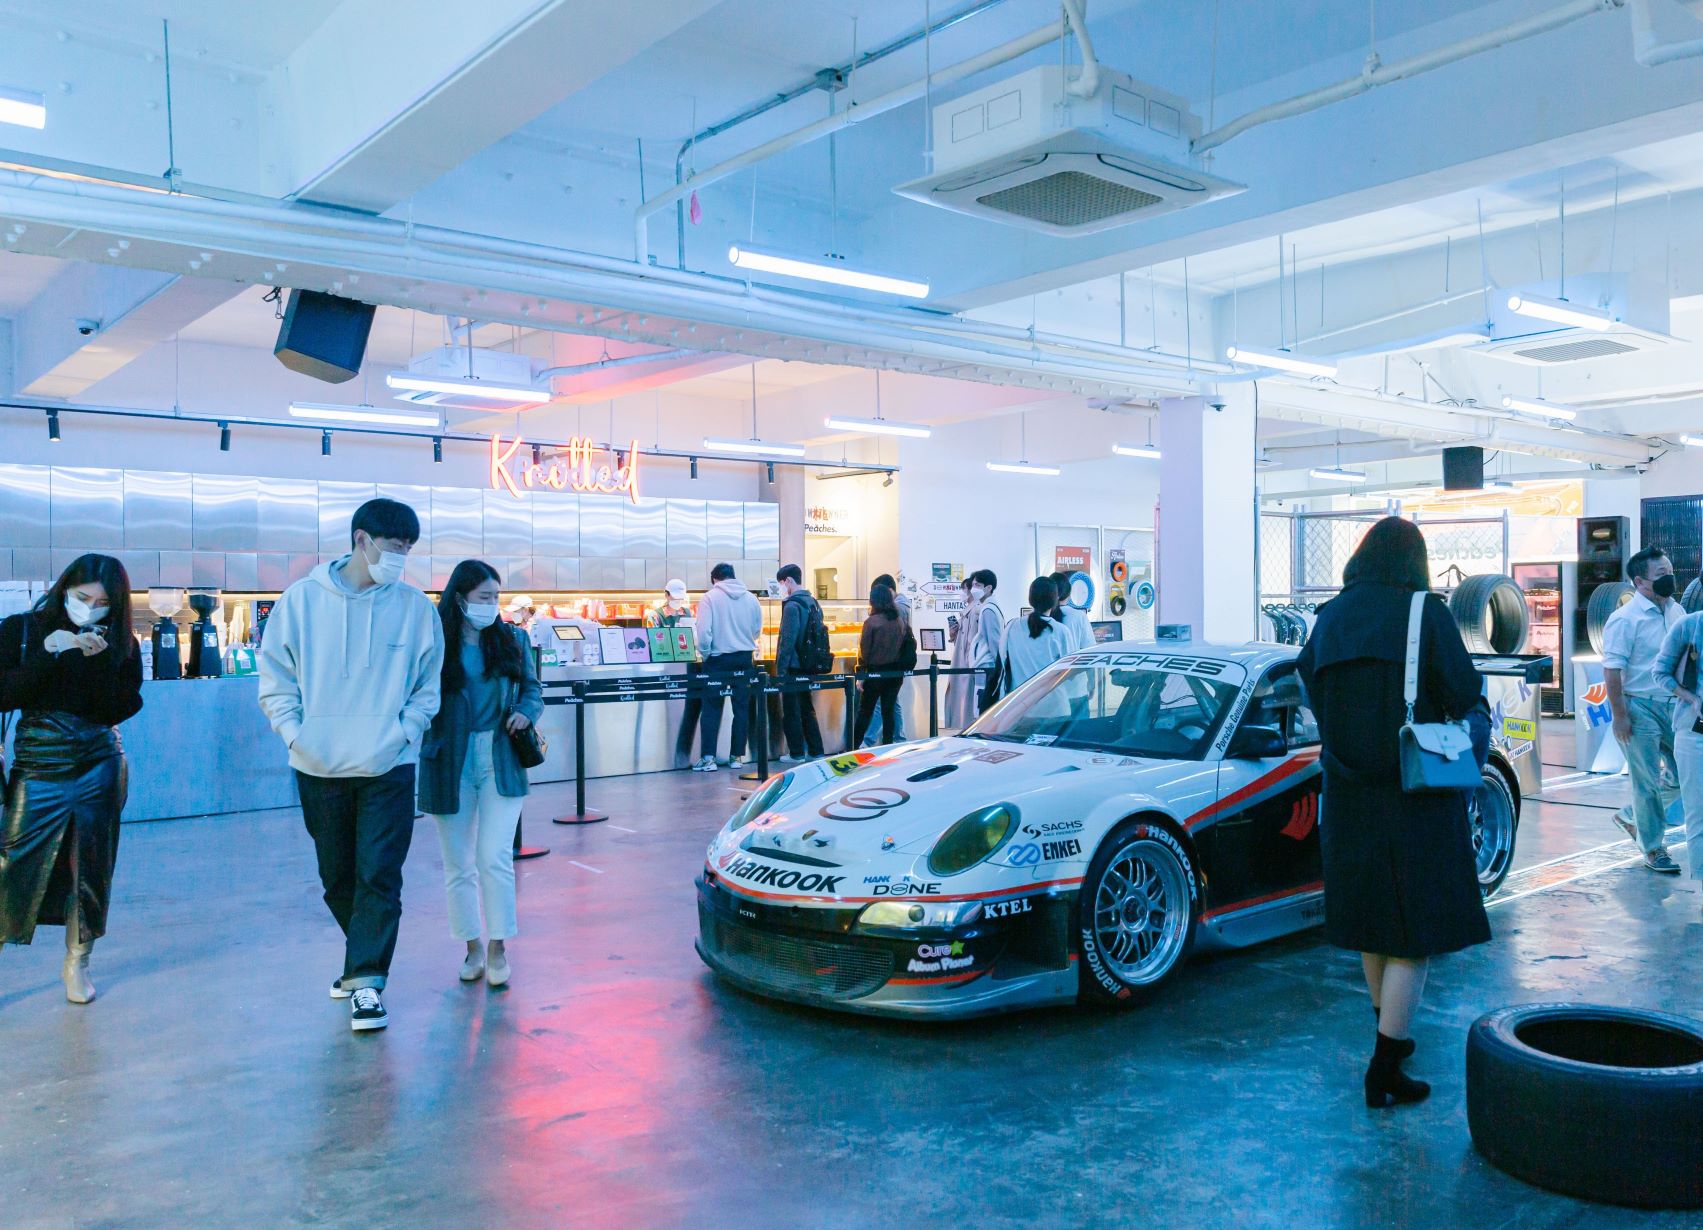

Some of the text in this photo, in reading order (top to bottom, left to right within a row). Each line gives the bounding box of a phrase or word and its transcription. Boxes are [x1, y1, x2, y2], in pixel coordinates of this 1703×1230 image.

[490, 433, 640, 505] Knotted
[1057, 556, 1084, 566] AIRLESS
[1057, 655, 1226, 676] PEACHES
[1215, 679, 1256, 752] Porsche Genuine Parts
[1041, 820, 1083, 831] SACHS
[1041, 839, 1082, 860] ENKEI
[984, 898, 1032, 919] KTEL
[918, 944, 952, 958] Cure
[907, 955, 974, 972] Album Planet
